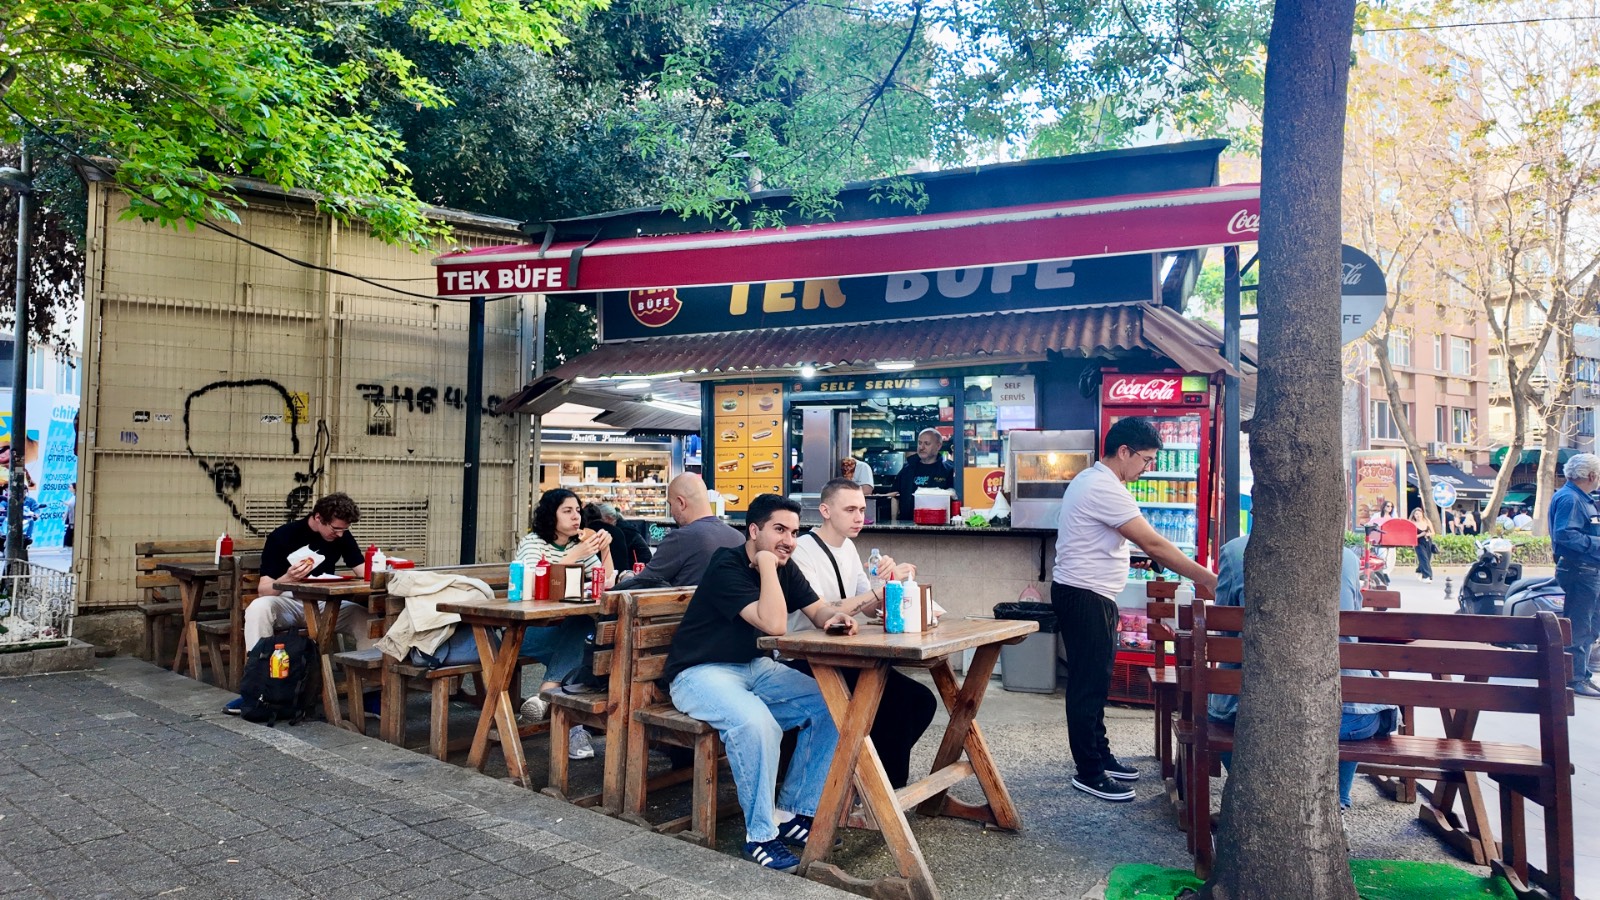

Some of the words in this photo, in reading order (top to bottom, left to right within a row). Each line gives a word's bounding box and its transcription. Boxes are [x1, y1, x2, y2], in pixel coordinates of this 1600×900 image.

[443, 270, 490, 291] TEK
[498, 264, 562, 289] BÜFE
[820, 382, 855, 392] SELF
[865, 379, 921, 390] SERVİS
[1004, 382, 1021, 390] SELF
[1109, 379, 1179, 400] Coca-Cola
[1000, 393, 1026, 401] SERVİS
